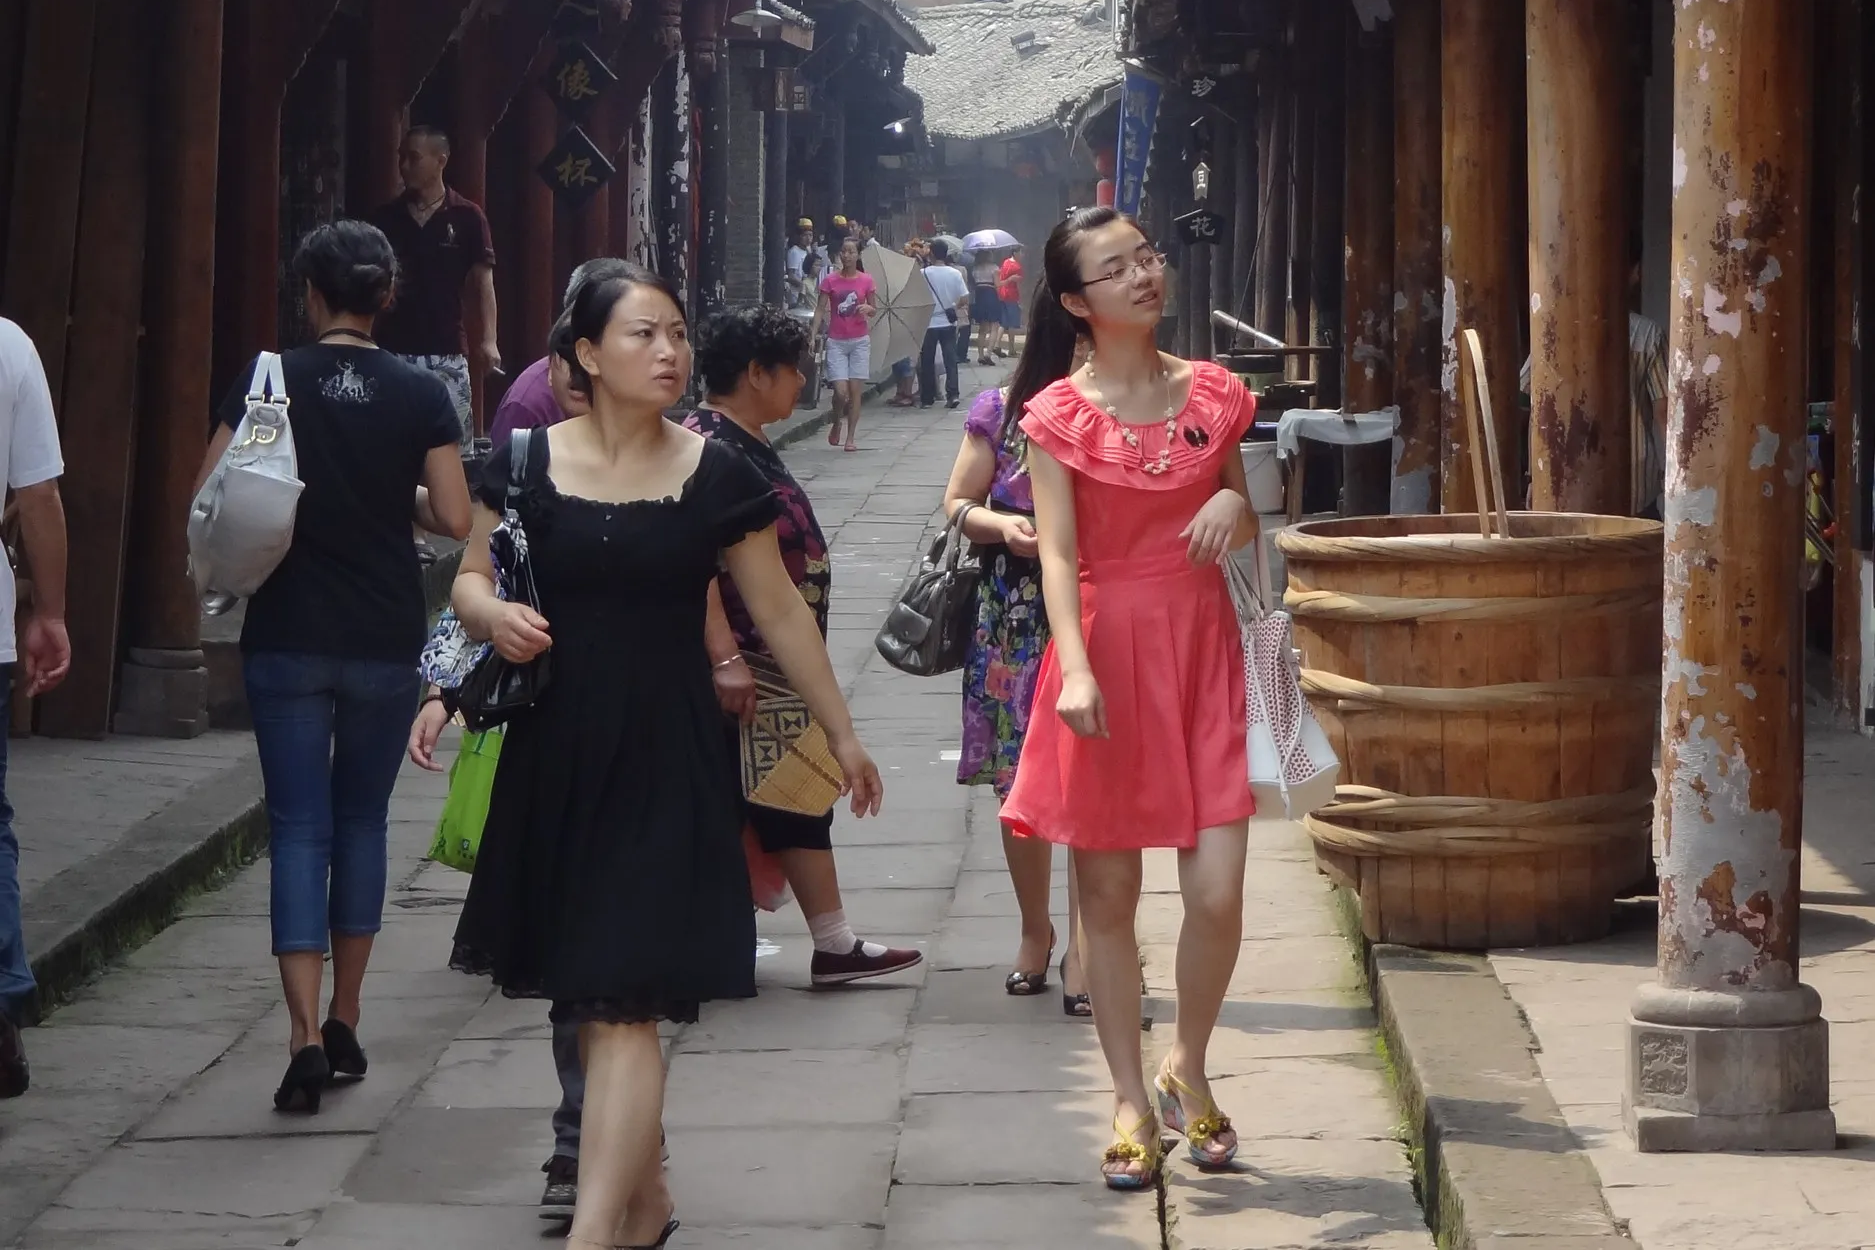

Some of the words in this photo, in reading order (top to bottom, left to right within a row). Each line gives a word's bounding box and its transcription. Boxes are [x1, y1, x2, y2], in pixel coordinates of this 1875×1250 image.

[1191, 76, 1217, 98] 珍
[1197, 170, 1206, 188] 豆
[1190, 216, 1216, 238] 花
